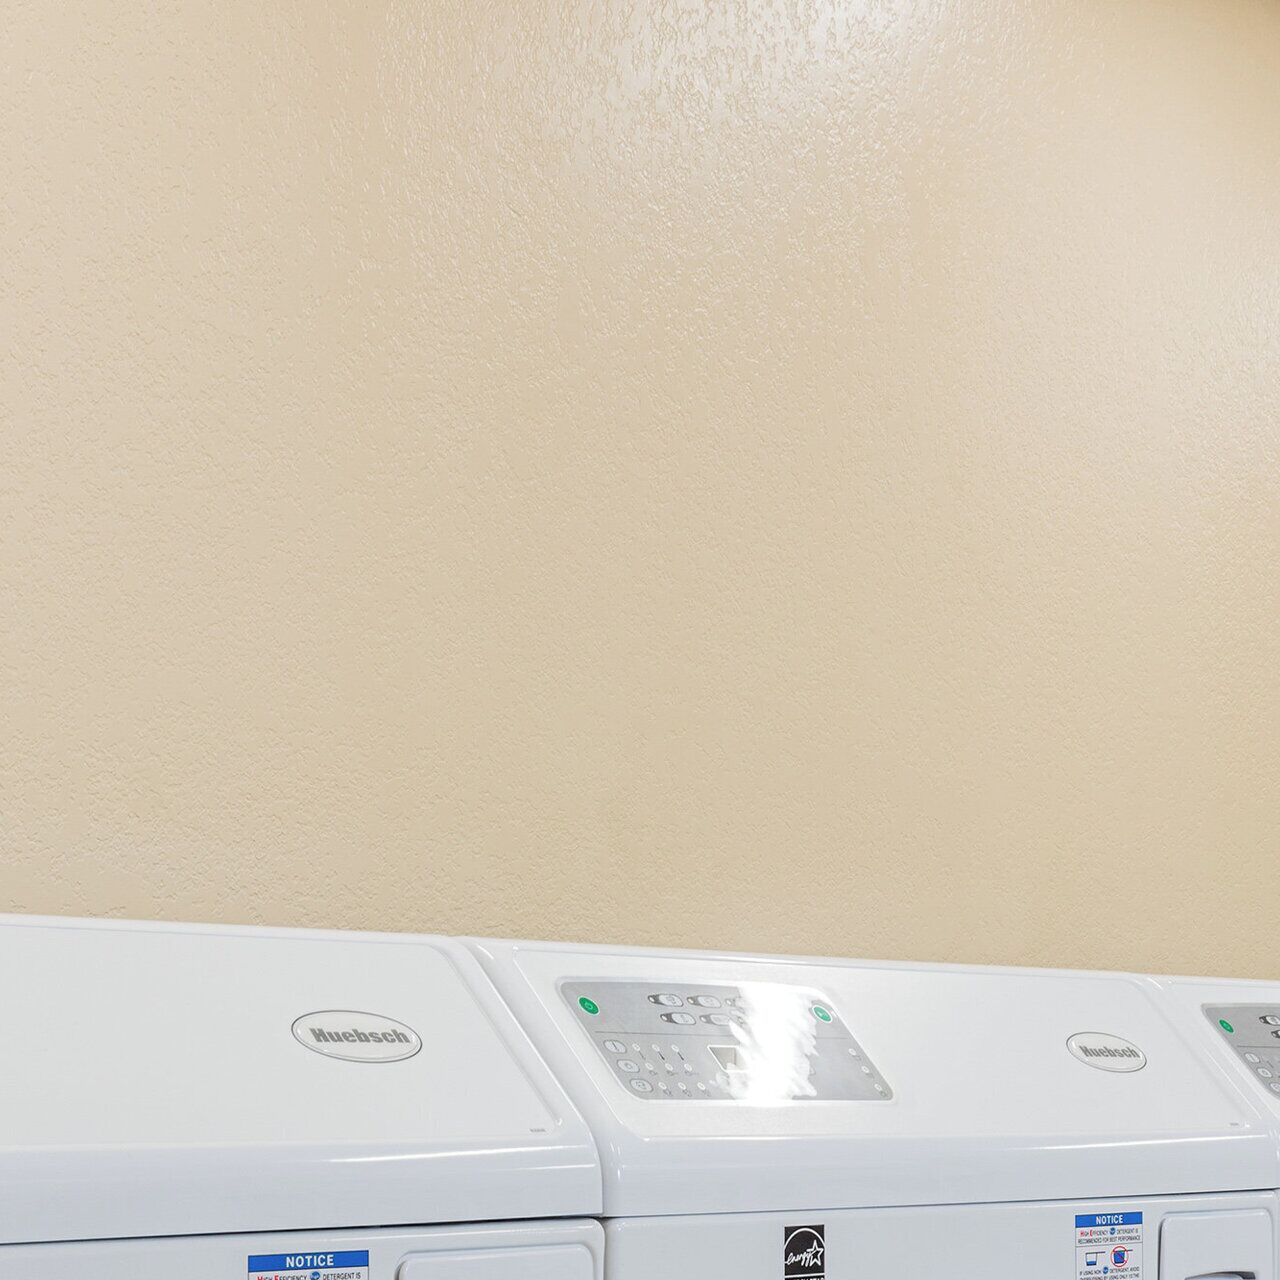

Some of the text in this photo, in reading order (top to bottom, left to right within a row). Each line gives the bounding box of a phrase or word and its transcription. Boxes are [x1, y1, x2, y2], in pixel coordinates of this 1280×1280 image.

[309, 1027, 410, 1043] Huebsch
[1079, 1045, 1141, 1058] Huebsch
[1095, 1214, 1124, 1225] NOTICE
[286, 1254, 334, 1268] NOTICE
[322, 1272, 355, 1280] DETERGENT
